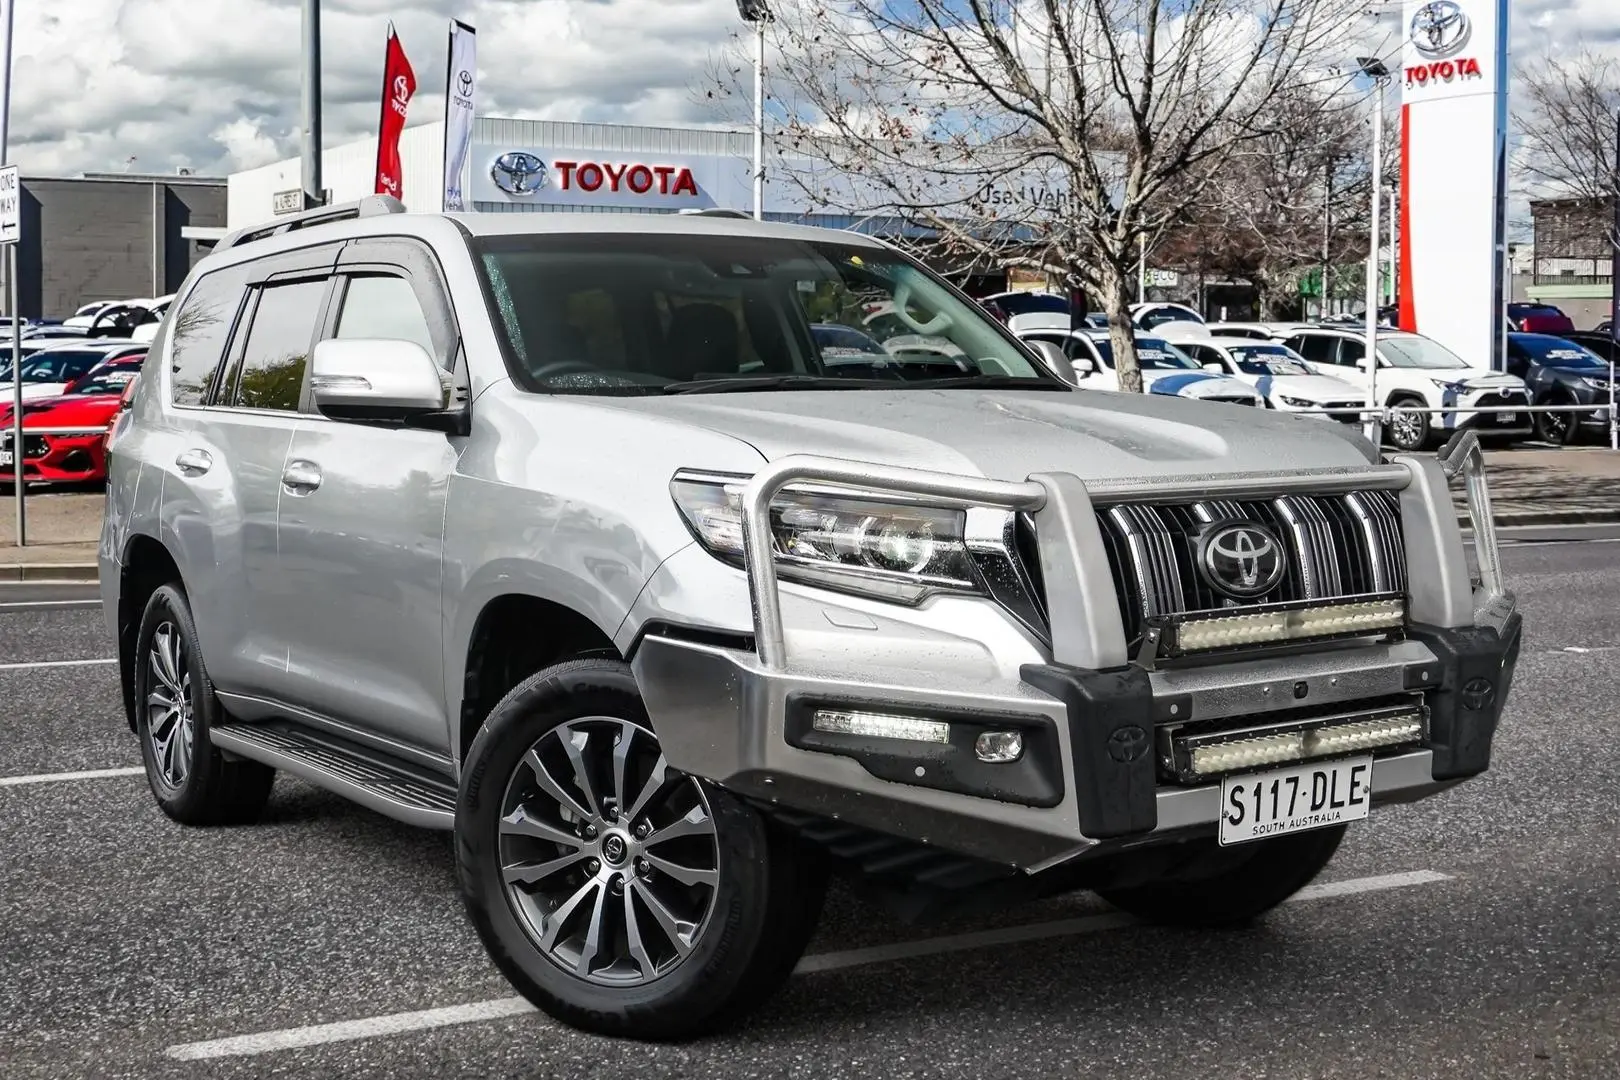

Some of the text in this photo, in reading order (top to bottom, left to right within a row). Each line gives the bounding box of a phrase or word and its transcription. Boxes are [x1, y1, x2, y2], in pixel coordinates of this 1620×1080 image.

[1404, 58, 1480, 82] TOYOTA
[1, 173, 15, 191] ONE
[555, 161, 698, 196] TOYOTA
[1252, 811, 1341, 835] SOUTH AUSTRALIA
